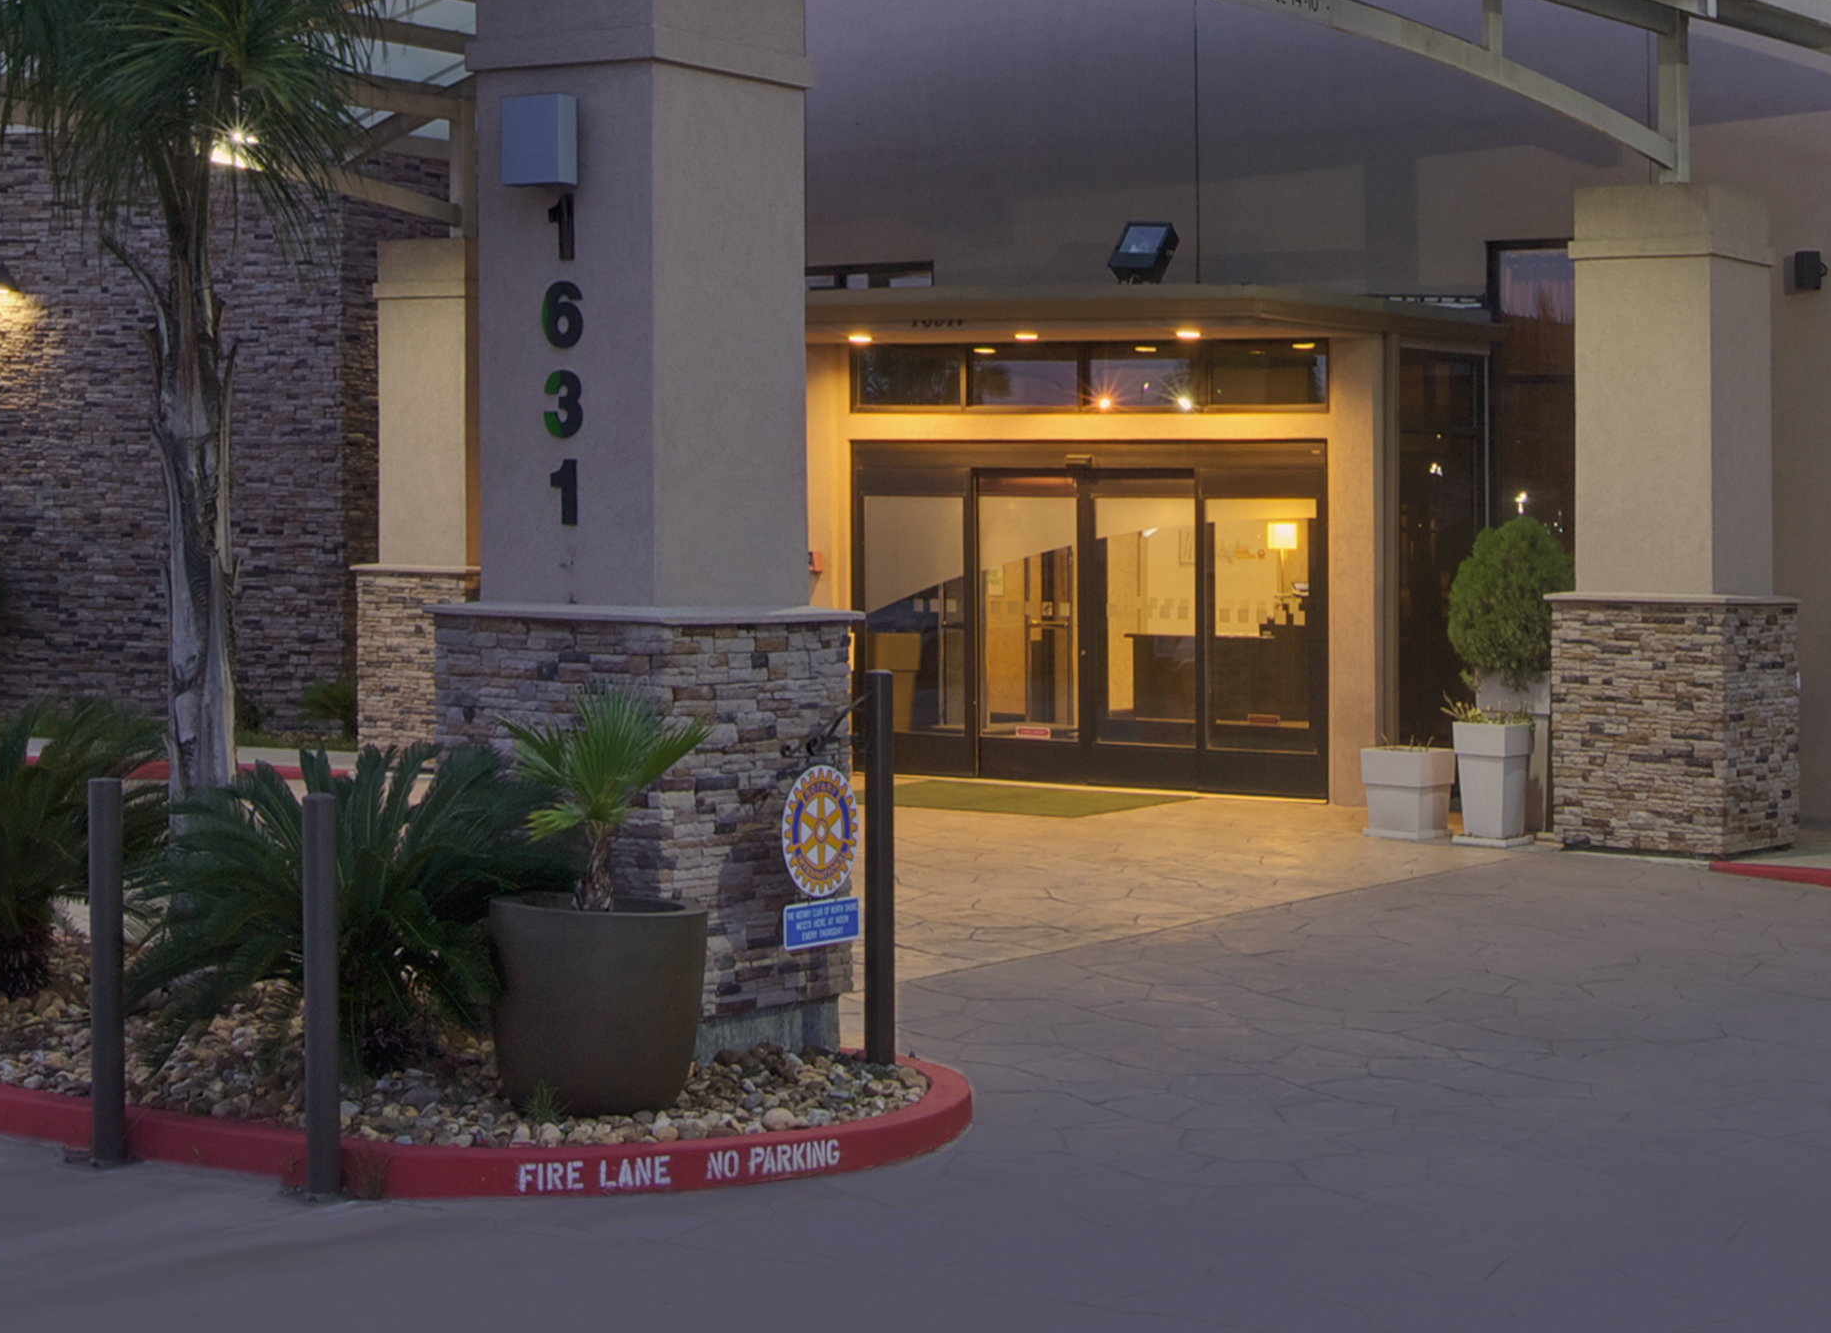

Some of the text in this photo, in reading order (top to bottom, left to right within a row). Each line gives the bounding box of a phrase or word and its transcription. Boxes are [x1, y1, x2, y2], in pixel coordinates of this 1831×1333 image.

[517, 1139, 841, 1193] FIRE LANE NO PARKING
